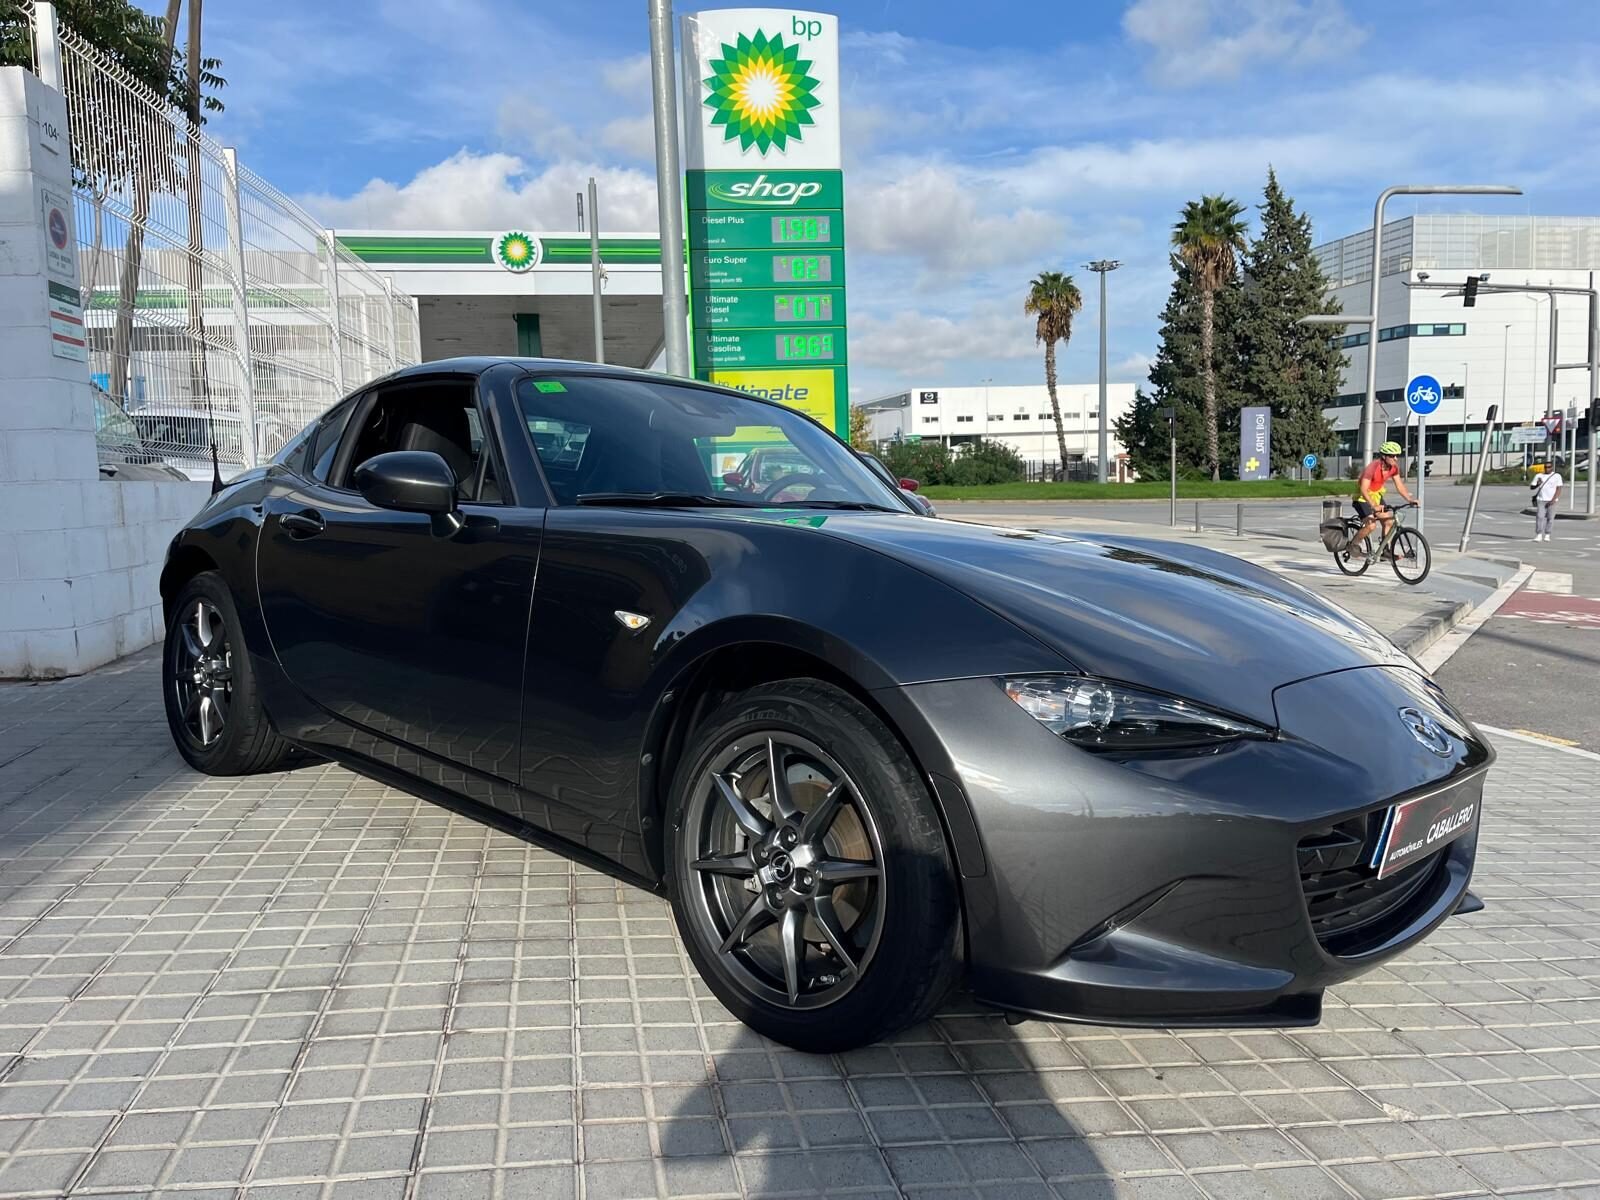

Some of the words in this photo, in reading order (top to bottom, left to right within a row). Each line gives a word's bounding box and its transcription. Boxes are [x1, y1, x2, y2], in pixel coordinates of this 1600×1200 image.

[792, 15, 822, 41] bp
[727, 174, 823, 206] shop
[702, 216, 726, 224] Diesel
[727, 216, 745, 224] Plus
[703, 256, 723, 264] Euro
[723, 256, 748, 265] Super
[705, 295, 739, 304] Ultimate
[705, 305, 730, 314] Diesel
[706, 335, 740, 343] Ultimate
[707, 344, 742, 352] Gasolina
[1389, 839, 1424, 861] AUTOMÓVILES
[1426, 803, 1474, 844] CABALLERO
